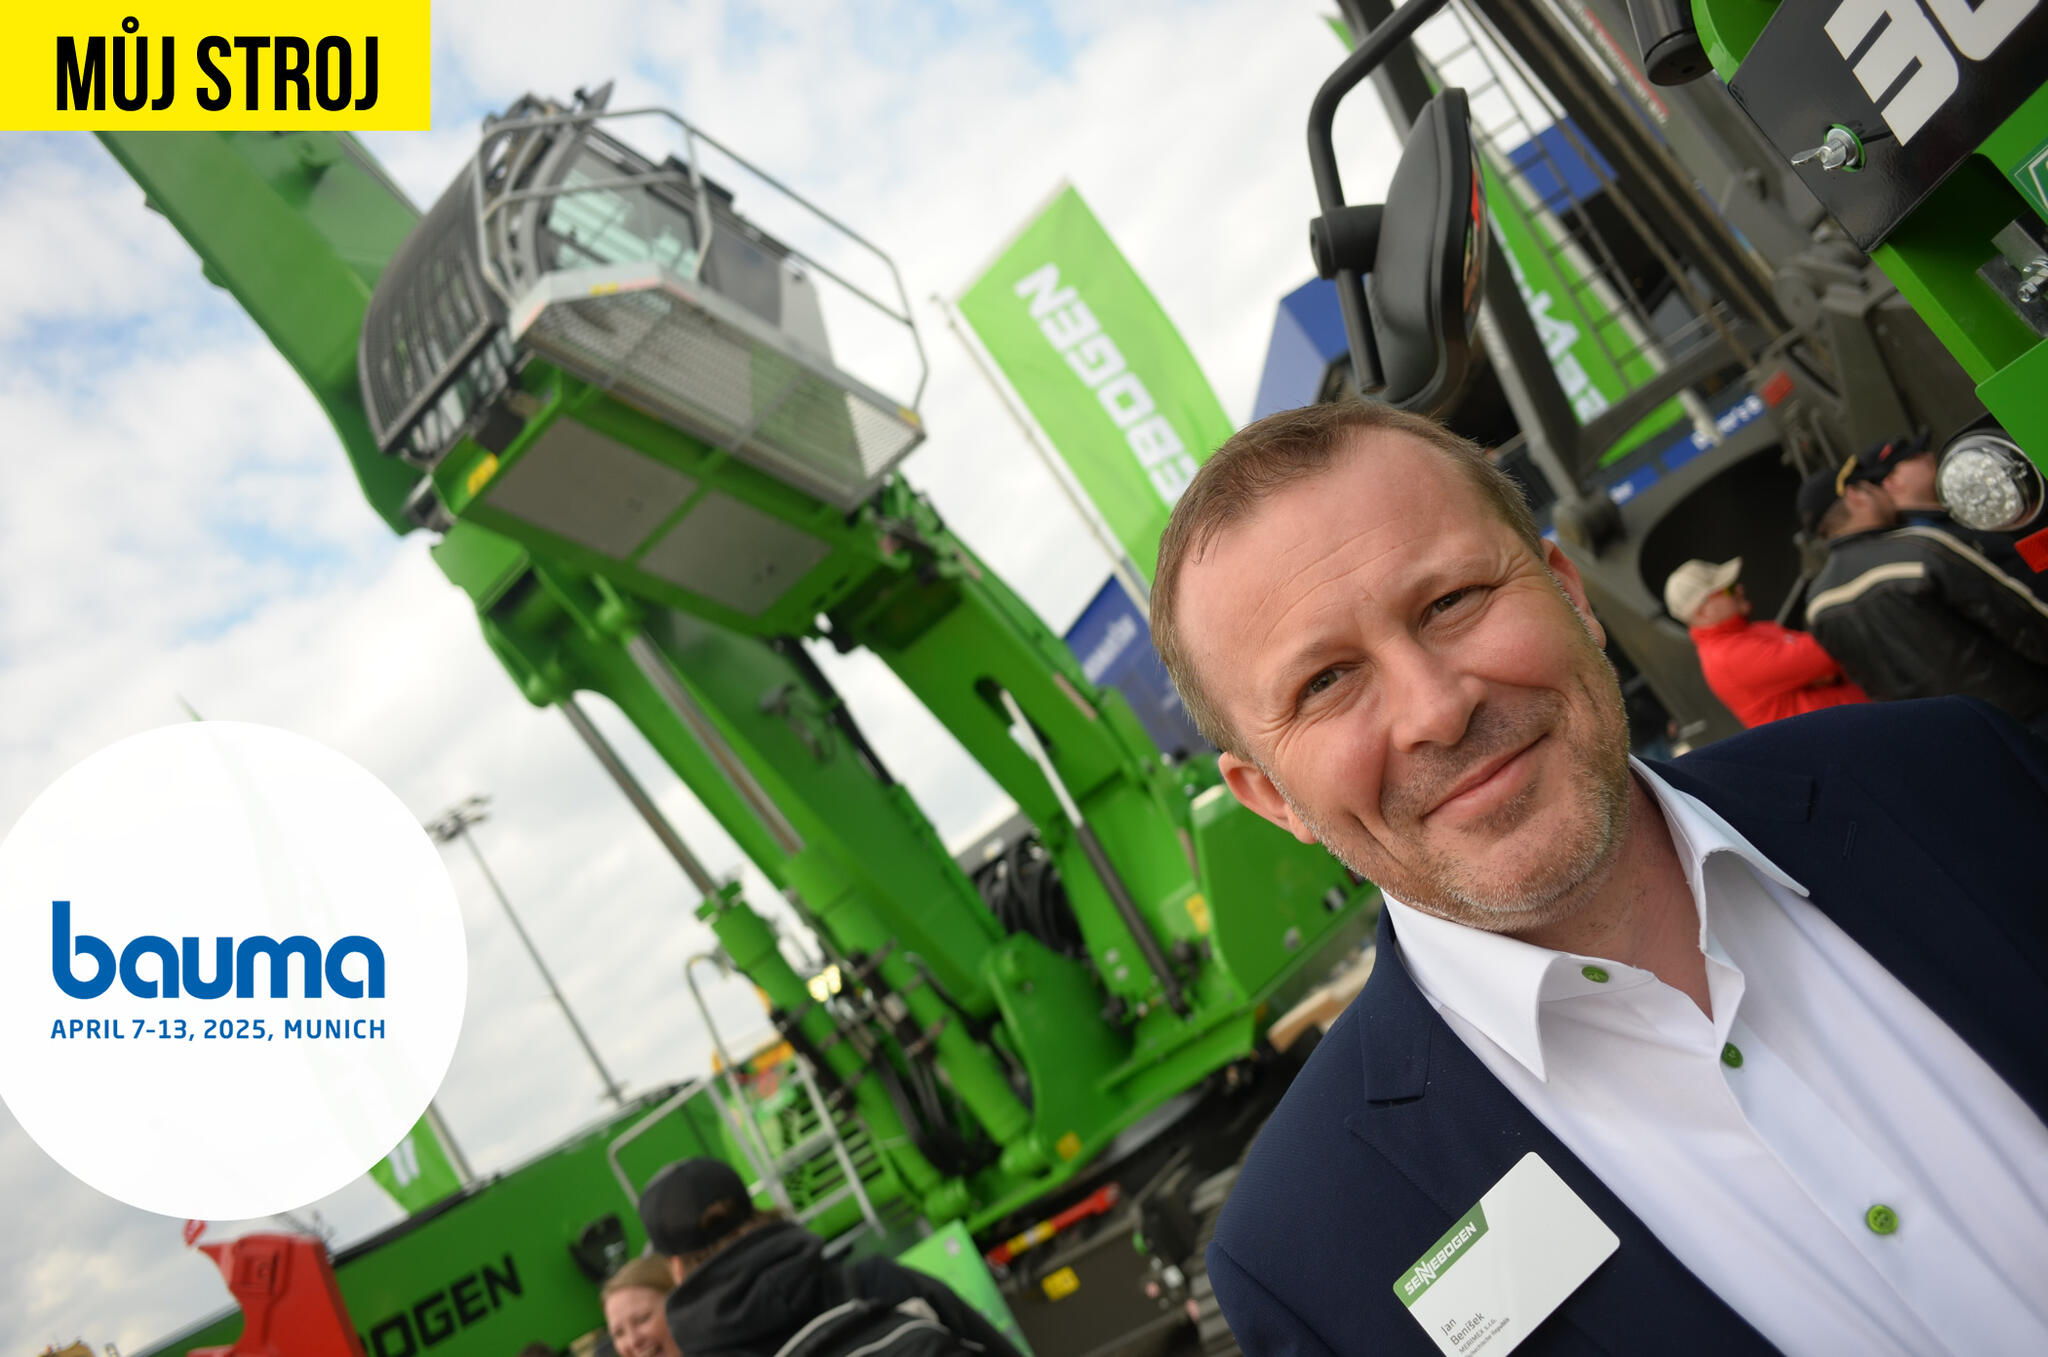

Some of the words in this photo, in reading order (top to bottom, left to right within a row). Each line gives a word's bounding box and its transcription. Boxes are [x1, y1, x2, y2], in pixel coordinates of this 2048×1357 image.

[1404, 1221, 1477, 1296] SENNEBOGEN
[360, 1253, 522, 1357] OGEN
[1440, 1318, 1457, 1336] Jan
